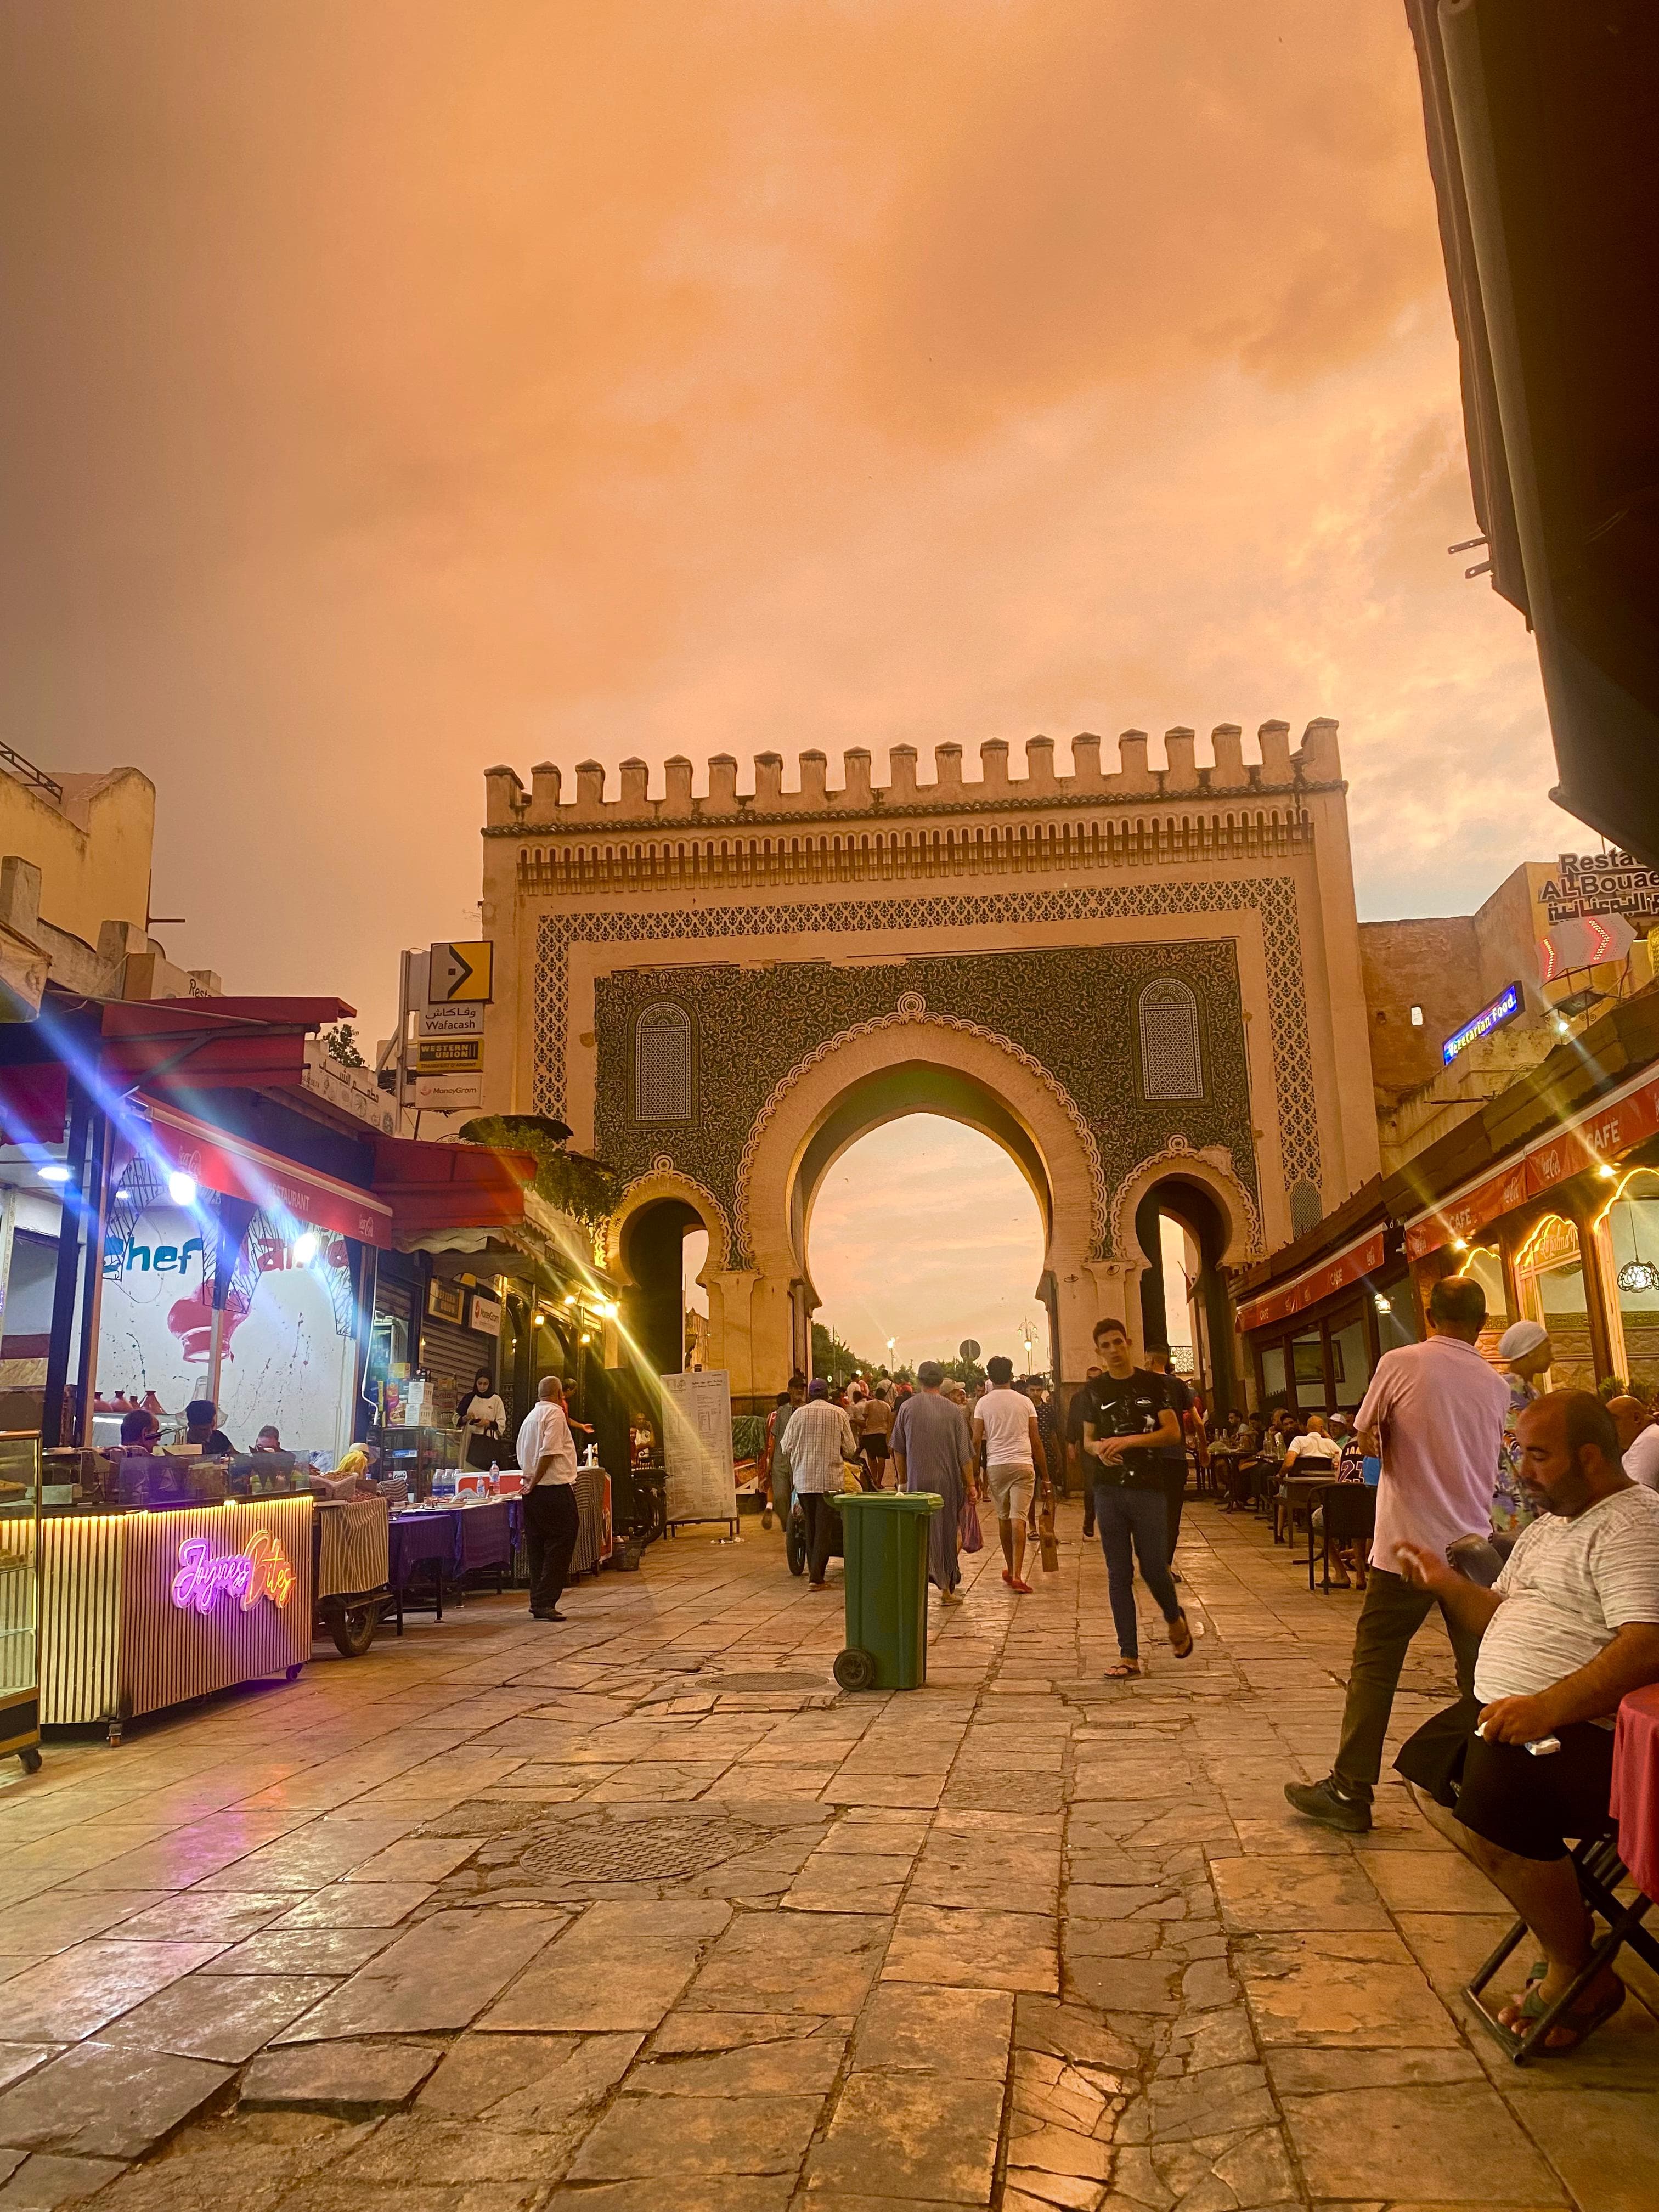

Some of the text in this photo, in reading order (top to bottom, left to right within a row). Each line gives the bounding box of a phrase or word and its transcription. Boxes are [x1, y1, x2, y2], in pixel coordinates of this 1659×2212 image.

[425, 1007, 476, 1019] وفاكاش
[426, 1019, 475, 1030] Wafacash
[1448, 994, 1514, 1057] Vegetarian Food
[421, 1044, 469, 1052] WESTERN
[245, 1534, 297, 1606] Bites
